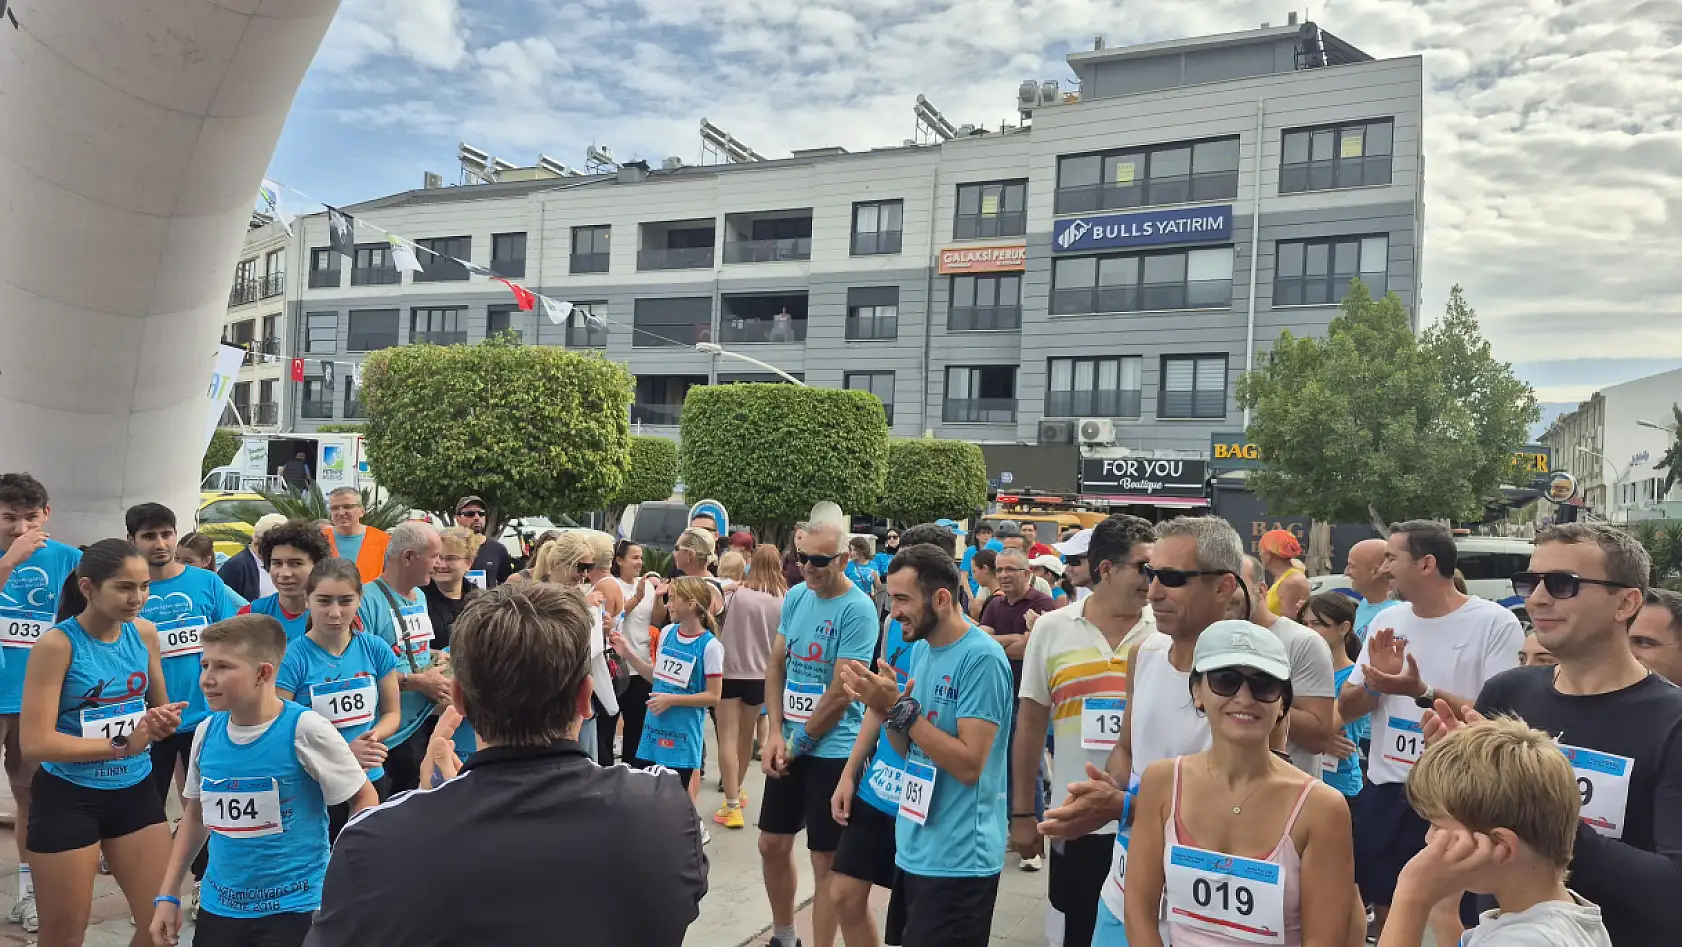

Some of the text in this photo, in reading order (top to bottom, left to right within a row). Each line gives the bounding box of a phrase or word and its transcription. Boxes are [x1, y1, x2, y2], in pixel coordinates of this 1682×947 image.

[1093, 216, 1223, 240] BULLS YATIRIM
[1102, 460, 1183, 477] FOR YOU
[1119, 477, 1164, 494] Boutique
[9, 622, 41, 638] 033
[168, 629, 198, 646] 065
[663, 659, 683, 675] 172
[328, 692, 365, 714] 168
[789, 695, 814, 711] 052
[100, 718, 136, 739] 171
[1095, 714, 1121, 734] 13
[905, 780, 924, 806] 051
[214, 797, 258, 820] 164
[1192, 877, 1255, 916] 019
